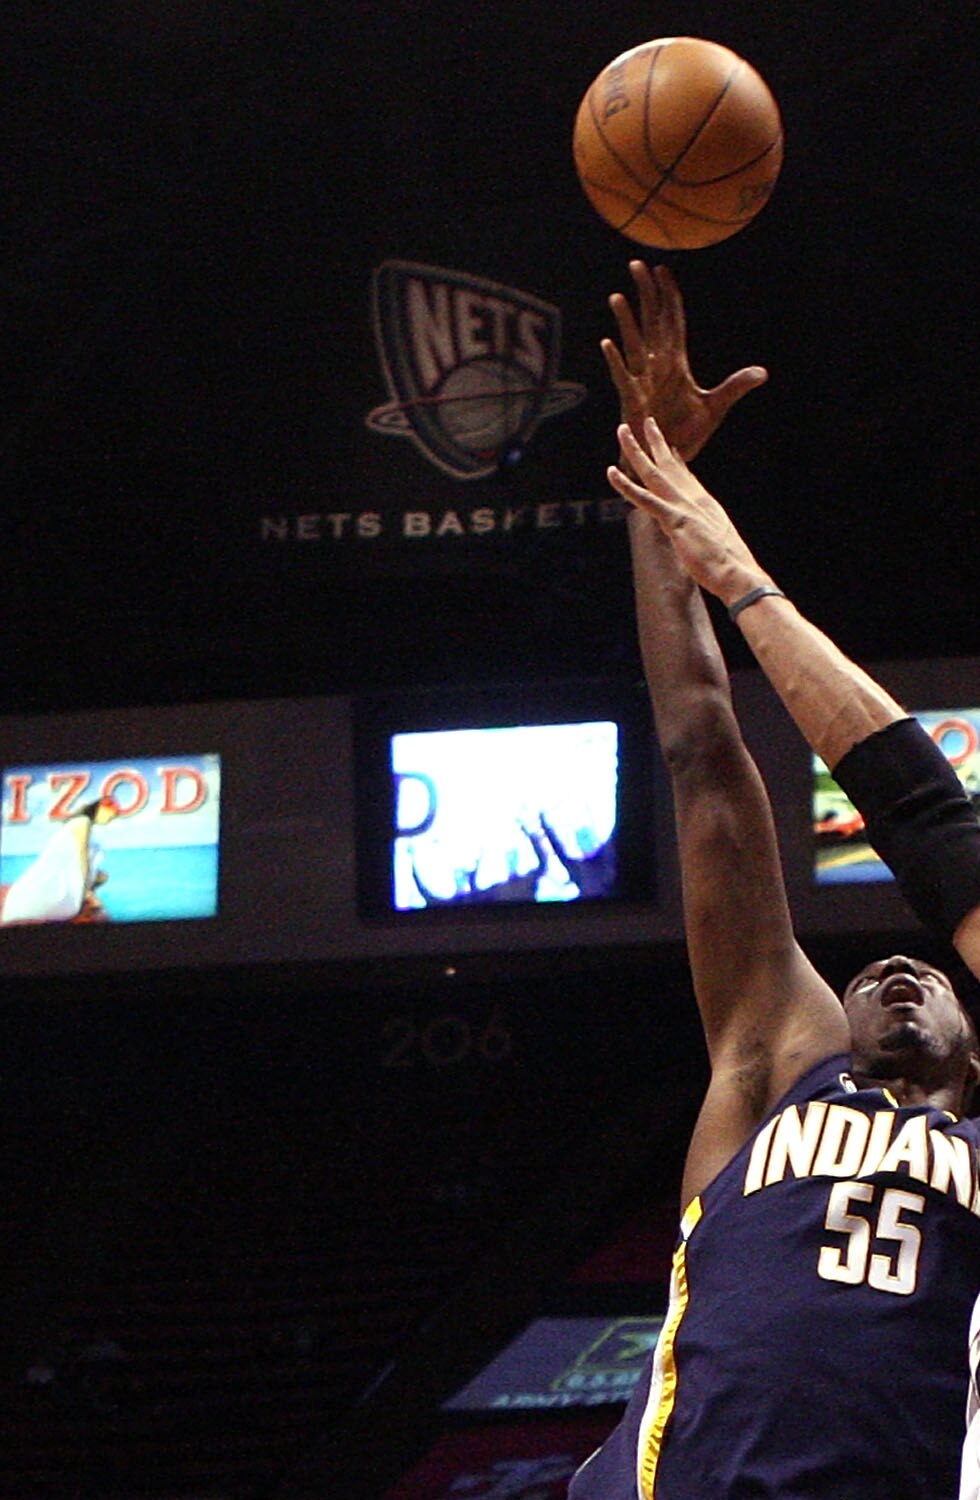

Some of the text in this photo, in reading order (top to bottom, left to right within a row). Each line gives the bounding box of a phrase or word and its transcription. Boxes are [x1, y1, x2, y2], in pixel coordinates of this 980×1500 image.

[406, 278, 548, 393] NETS
[260, 512, 384, 540] NETS
[6, 767, 208, 823] IZOD
[380, 1003, 512, 1068] 206
[816, 1180, 927, 1297] 55
